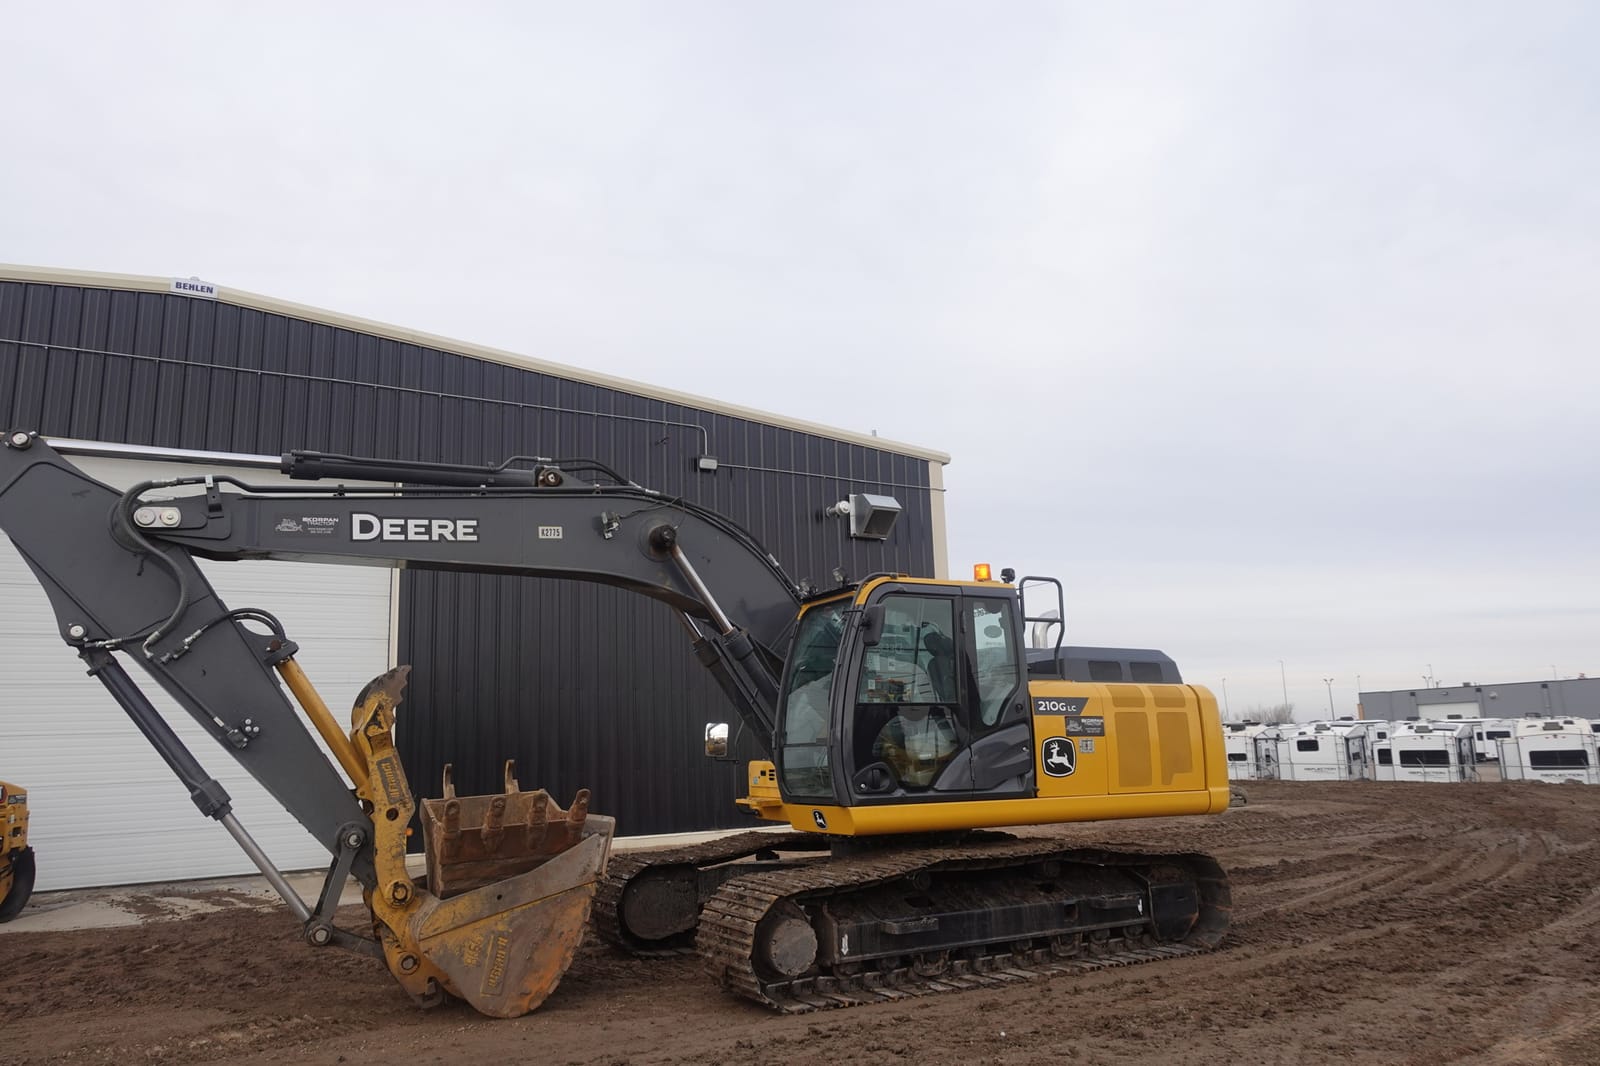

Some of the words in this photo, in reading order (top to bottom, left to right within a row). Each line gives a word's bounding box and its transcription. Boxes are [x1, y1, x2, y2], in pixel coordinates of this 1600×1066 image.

[175, 281, 214, 294] BEHLEN
[352, 513, 478, 541] DEERE
[541, 528, 560, 537] K2775
[1037, 701, 1067, 712] 210G
